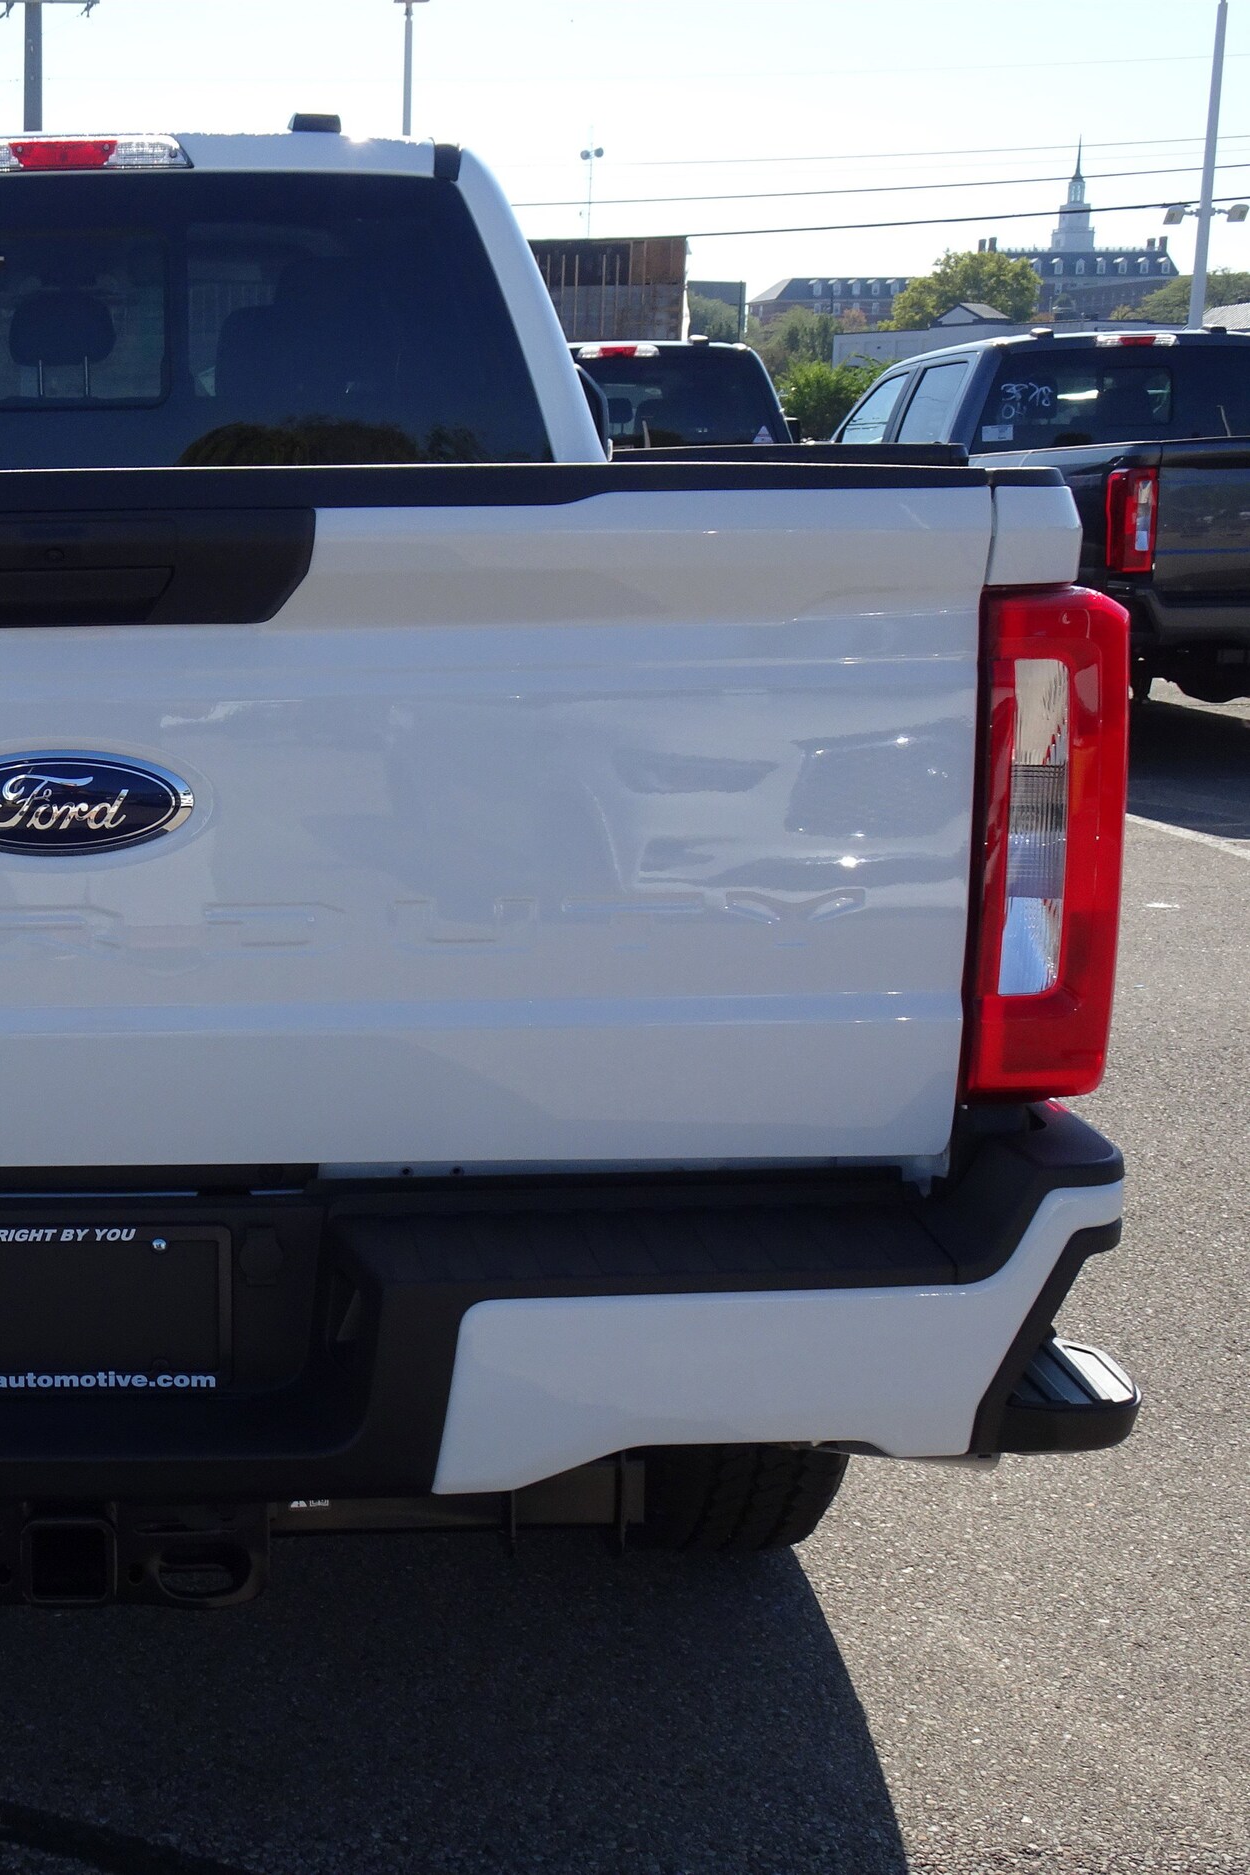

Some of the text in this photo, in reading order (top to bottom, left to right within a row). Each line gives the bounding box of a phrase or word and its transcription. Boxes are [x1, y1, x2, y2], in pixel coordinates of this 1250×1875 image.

[201, 888, 867, 958] DUTY
[60, 1229, 89, 1242] BY
[94, 1228, 136, 1241] YOU
